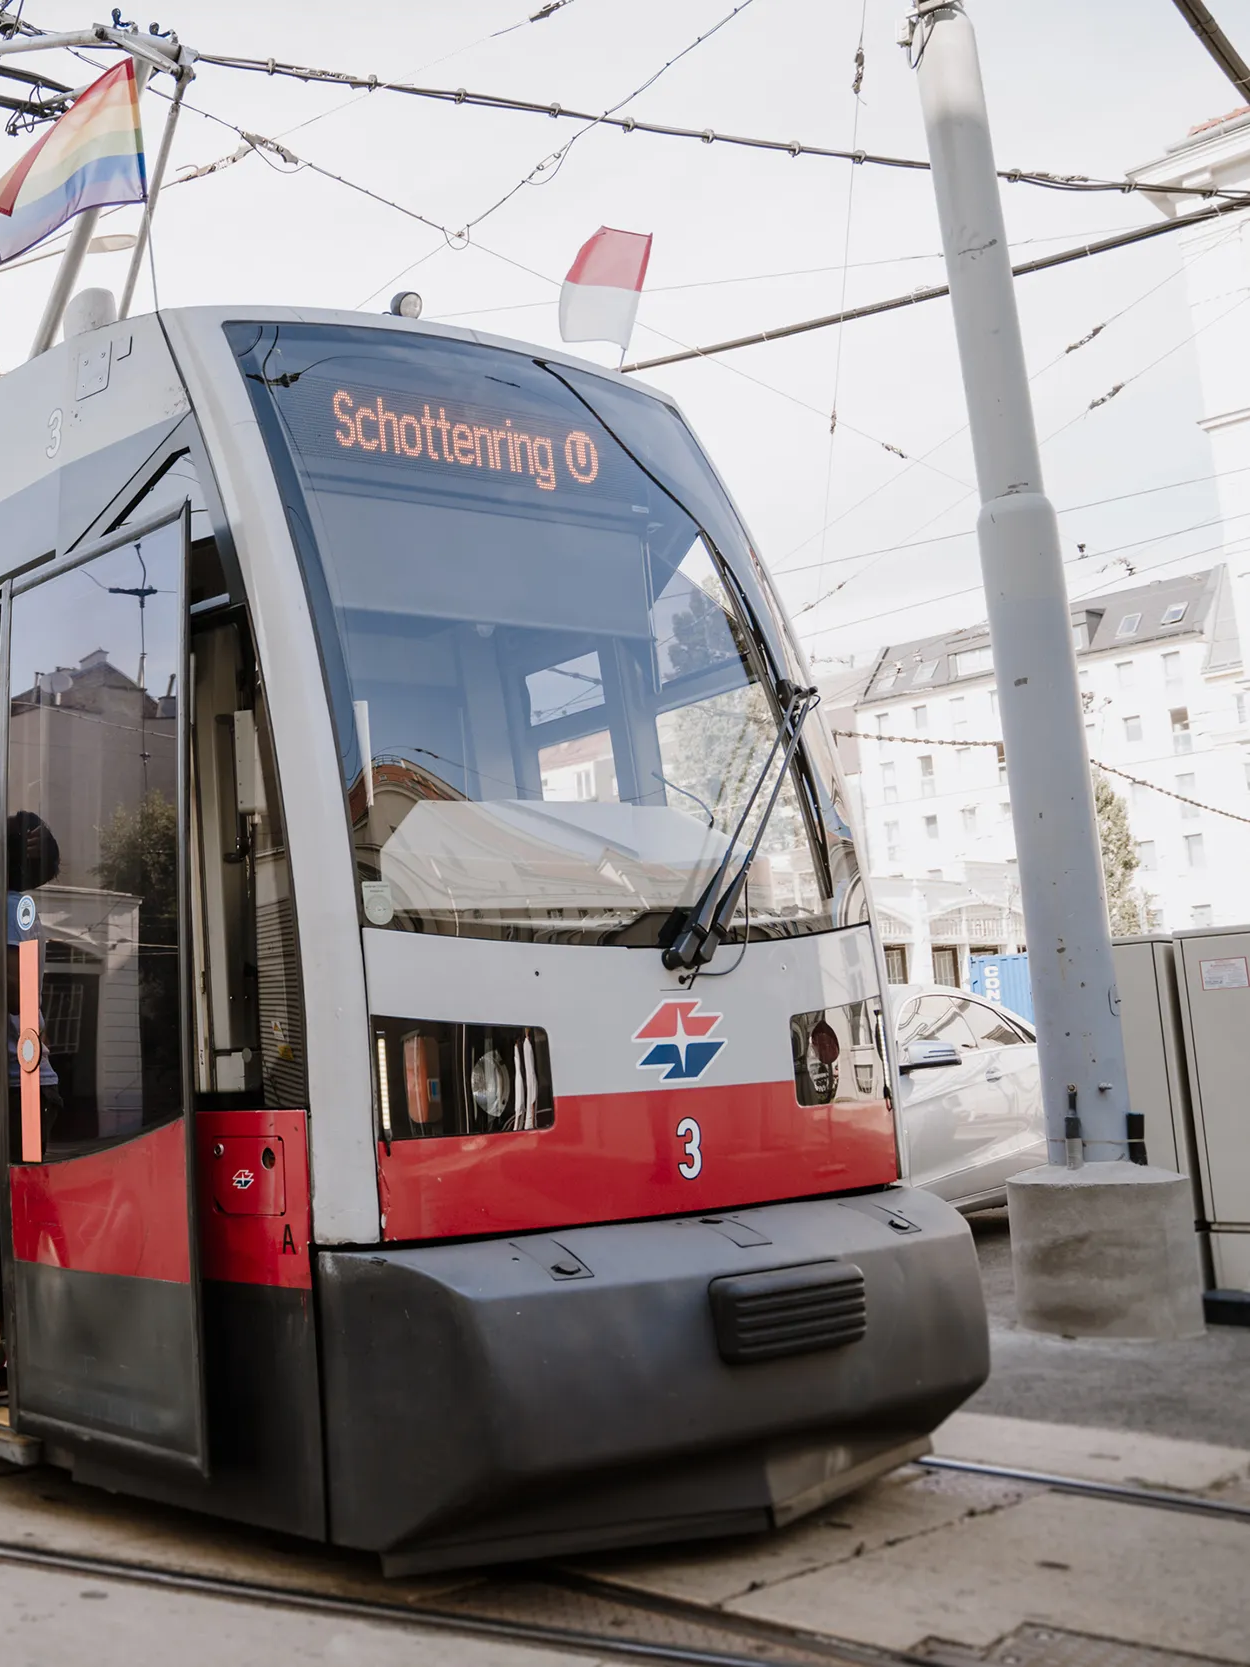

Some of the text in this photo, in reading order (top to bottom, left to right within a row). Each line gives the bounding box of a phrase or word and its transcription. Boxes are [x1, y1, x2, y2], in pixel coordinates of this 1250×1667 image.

[46, 407, 63, 459] 3
[333, 389, 557, 491] Schottenring
[675, 1115, 703, 1181] 3
[282, 1223, 297, 1255] A
